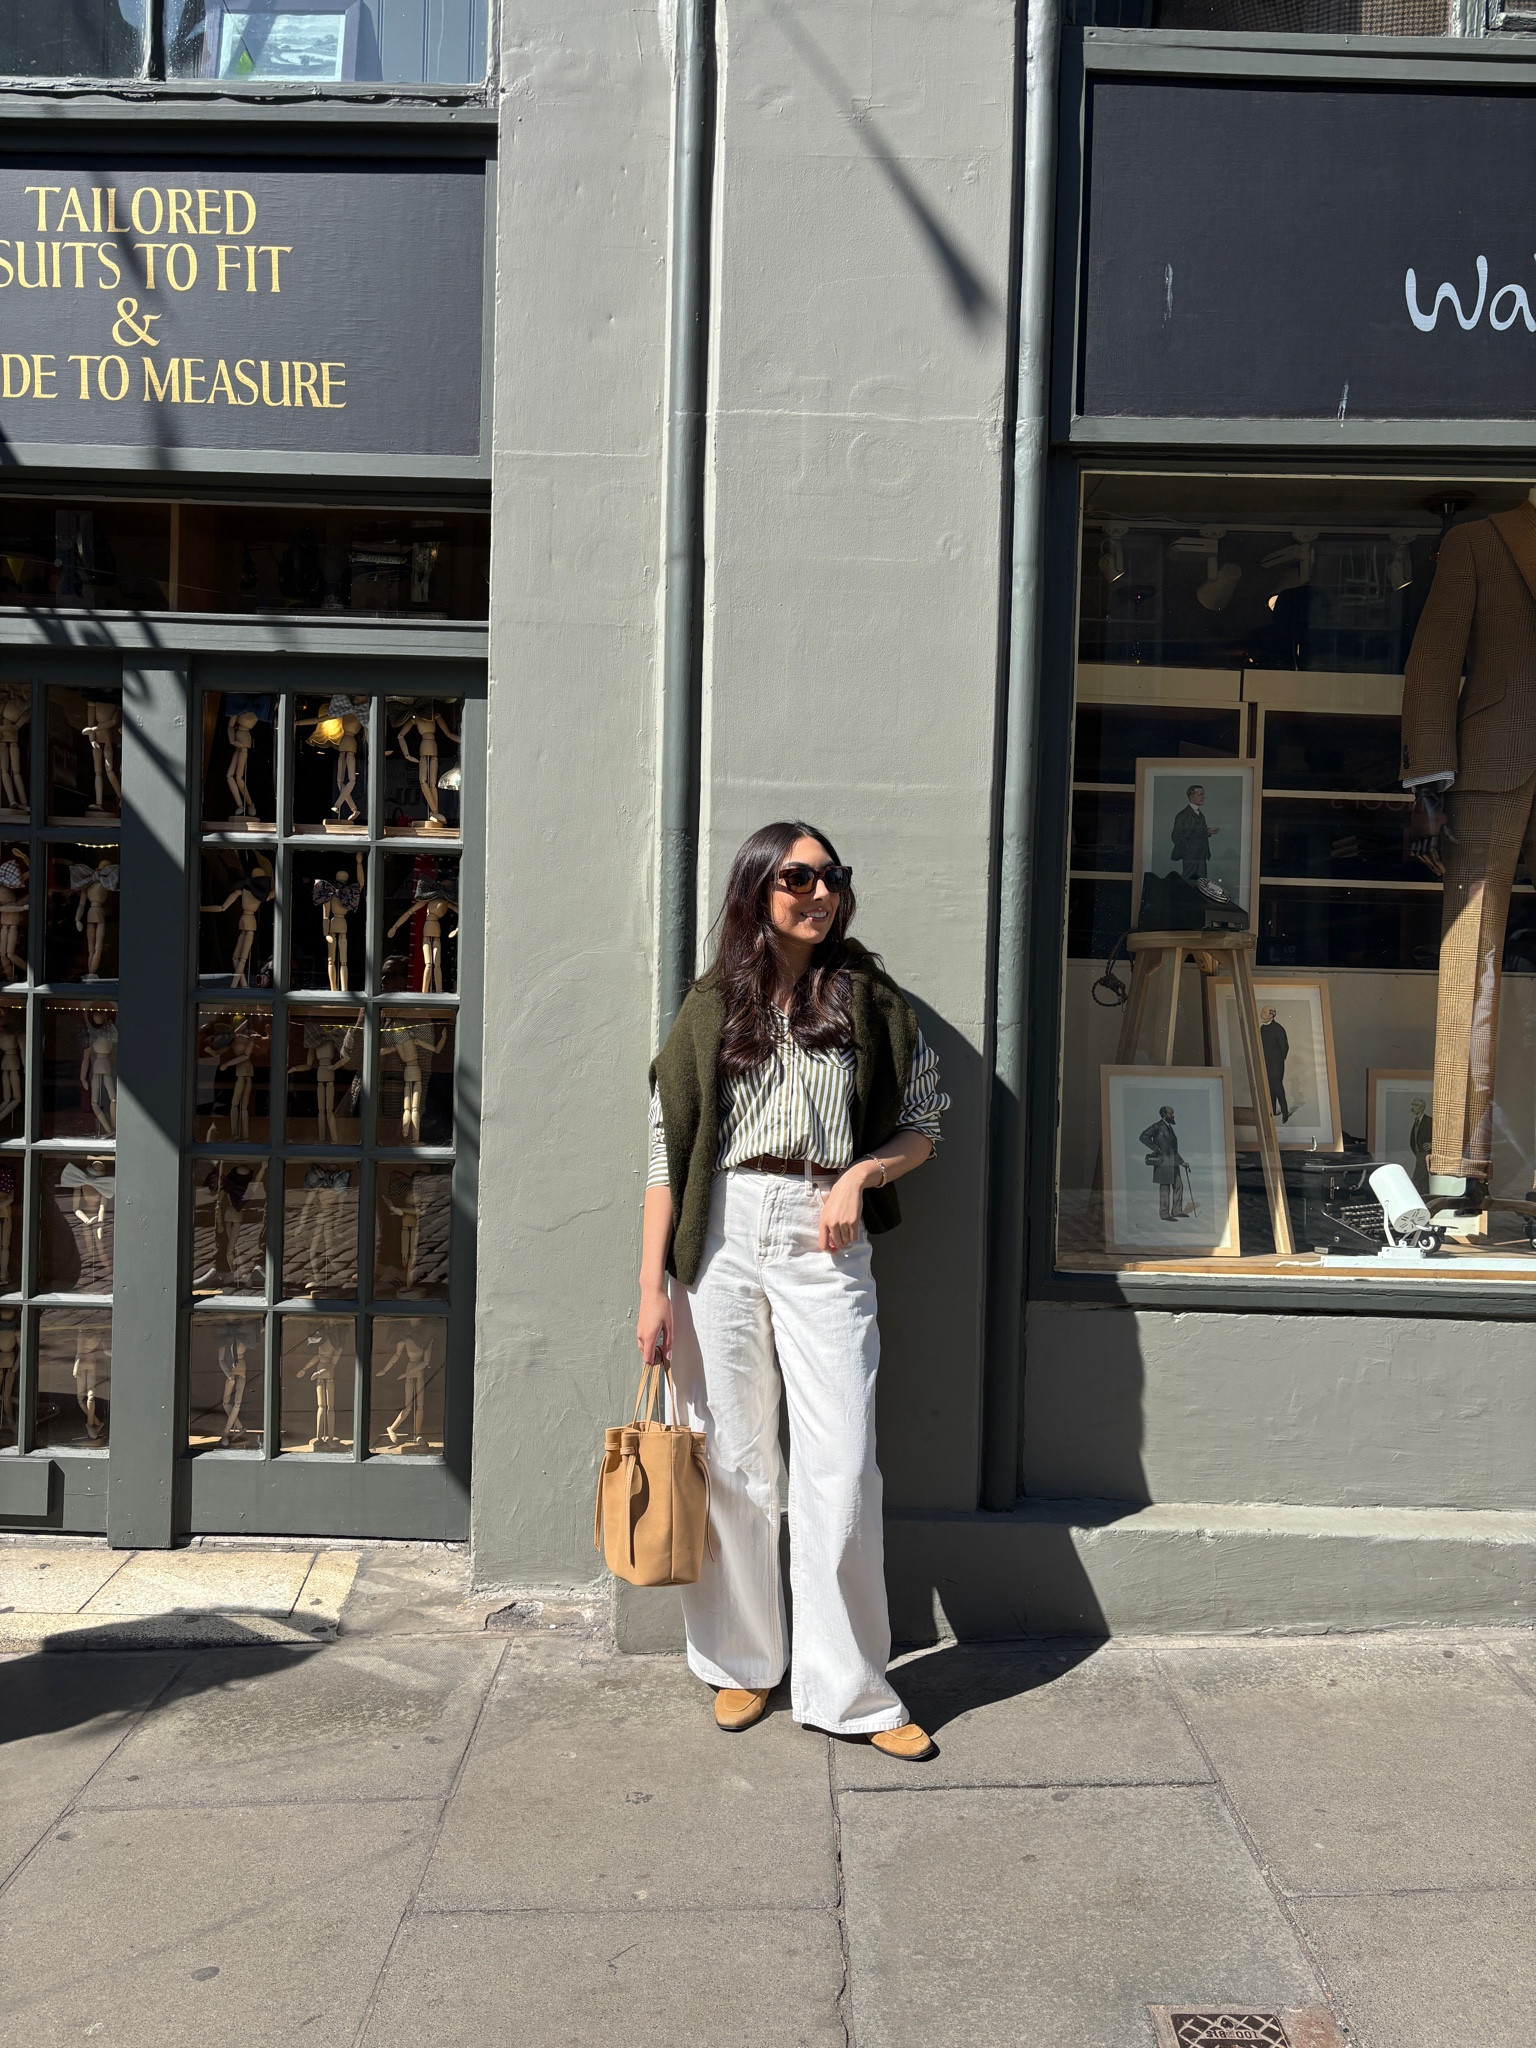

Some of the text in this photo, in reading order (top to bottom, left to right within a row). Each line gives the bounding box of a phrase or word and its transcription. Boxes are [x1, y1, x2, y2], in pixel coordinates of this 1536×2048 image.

[24, 186, 257, 236] TAILORED
[0, 240, 293, 293] SUITS TO FIT
[1405, 253, 1536, 333] Wa
[111, 297, 163, 348] &
[1, 353, 347, 409] DE TO MEASURE
